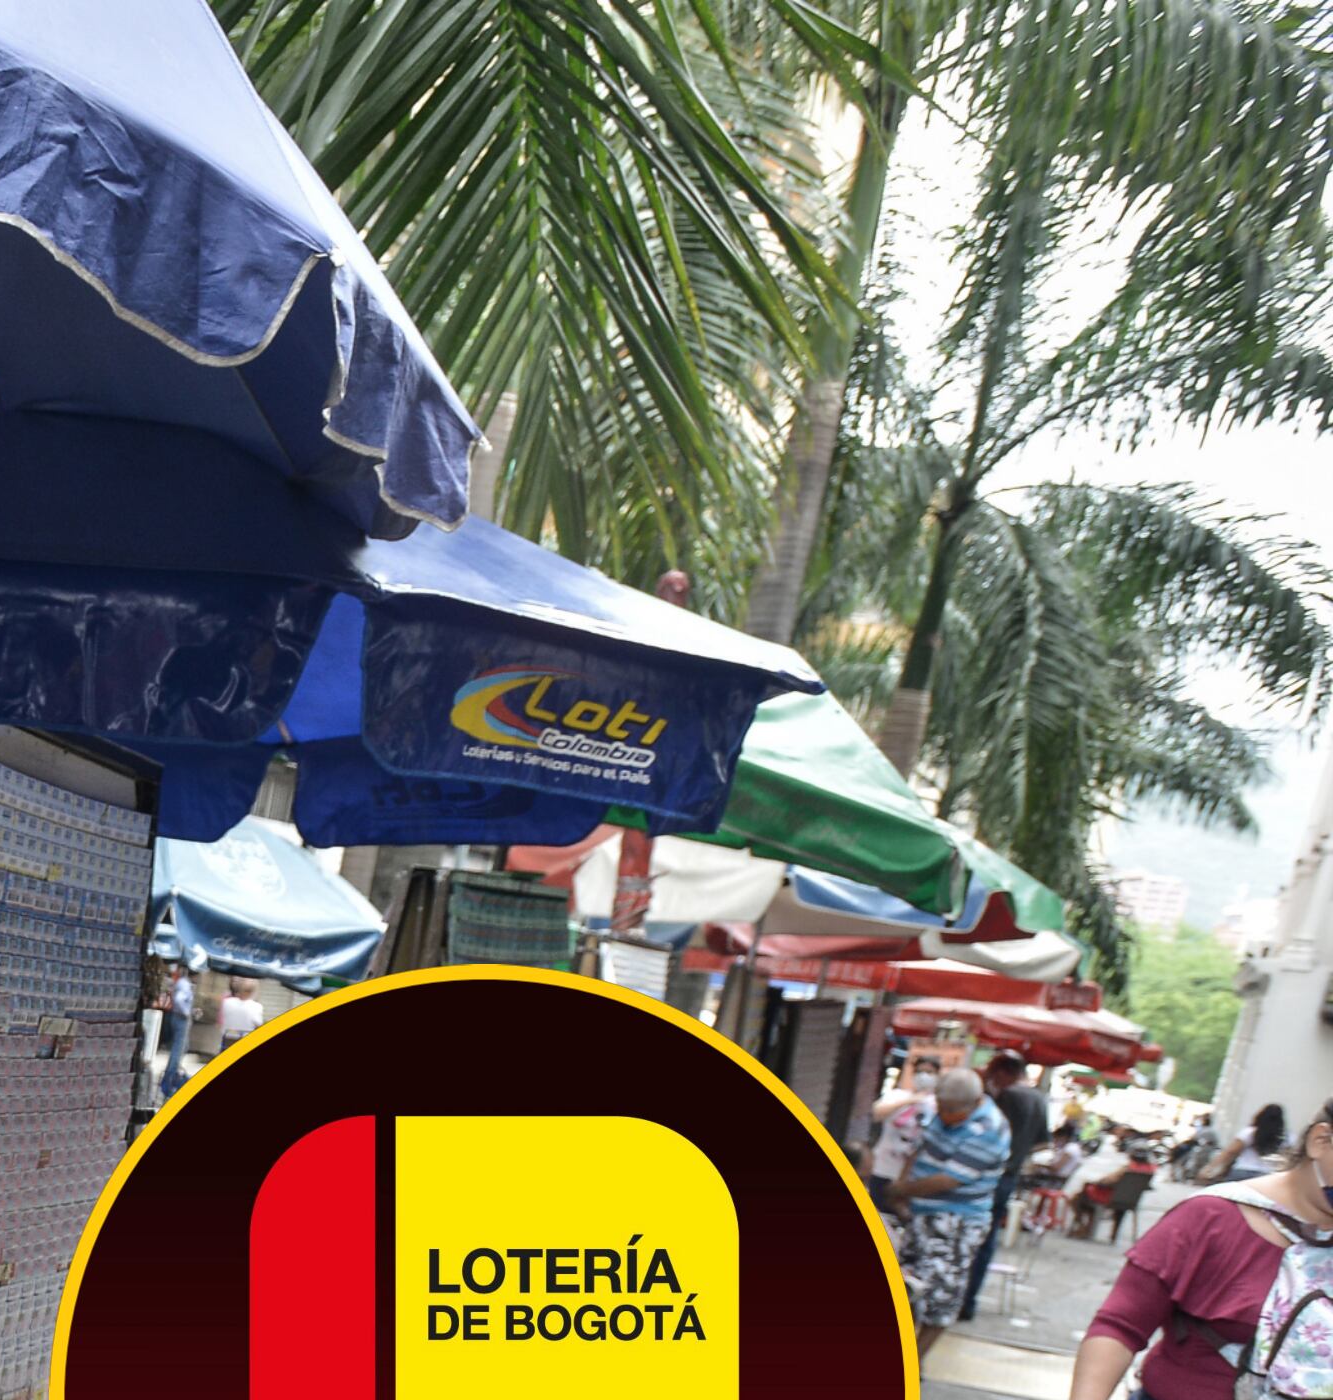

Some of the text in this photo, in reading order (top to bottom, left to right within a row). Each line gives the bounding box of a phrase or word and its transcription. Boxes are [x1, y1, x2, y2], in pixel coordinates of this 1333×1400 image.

[525, 675, 668, 746] Loti
[539, 729, 656, 768] Colombia
[572, 761, 601, 778] para
